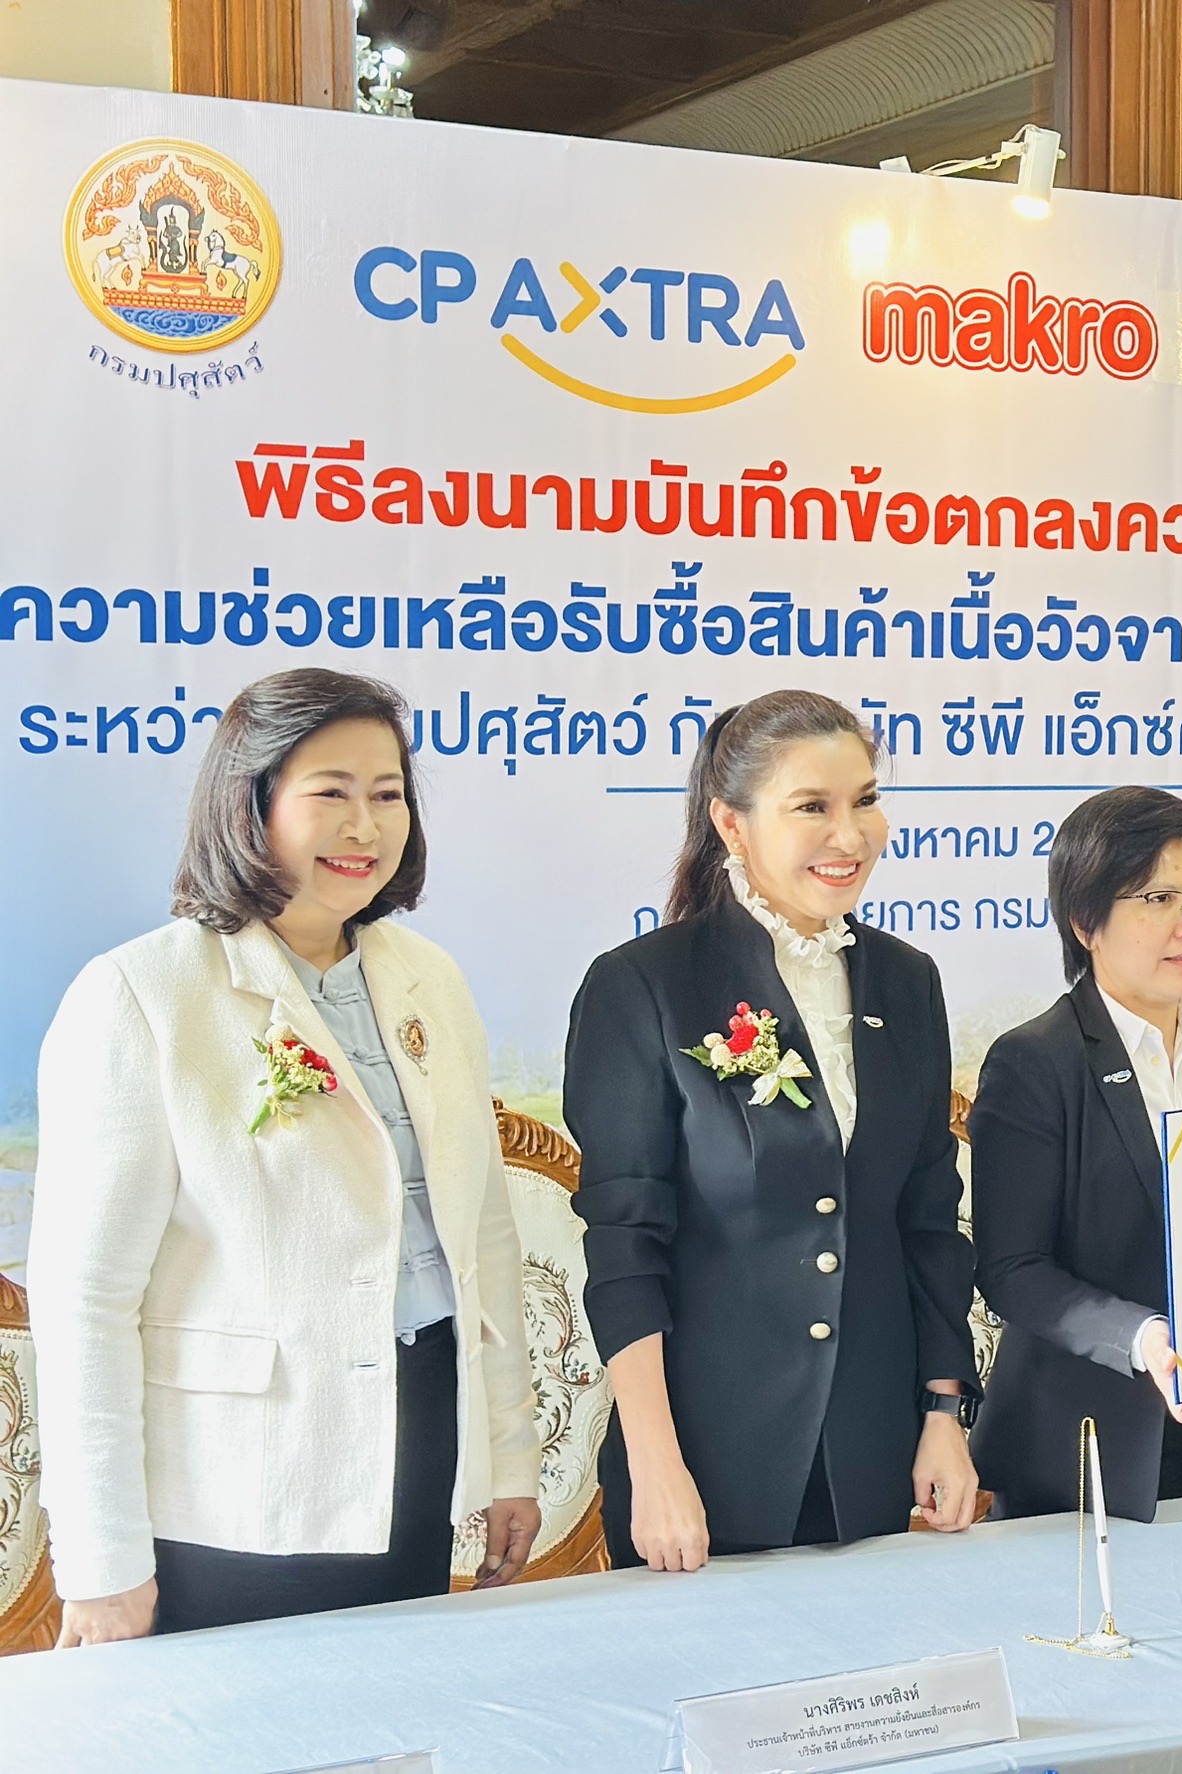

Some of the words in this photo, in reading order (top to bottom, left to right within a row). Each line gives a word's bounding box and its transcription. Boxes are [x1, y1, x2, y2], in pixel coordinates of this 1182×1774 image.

[354, 246, 477, 324] CP
[492, 257, 807, 352] AXTRA
[863, 270, 1160, 381] makro
[88, 341, 266, 399] กรมปศุสัตว์
[411, 690, 649, 776] ปศุสัตว์
[941, 696, 1025, 756] ซีพี
[803, 1696, 865, 1719] นางศิริพร
[869, 1682, 920, 1708] เดชสิงห์
